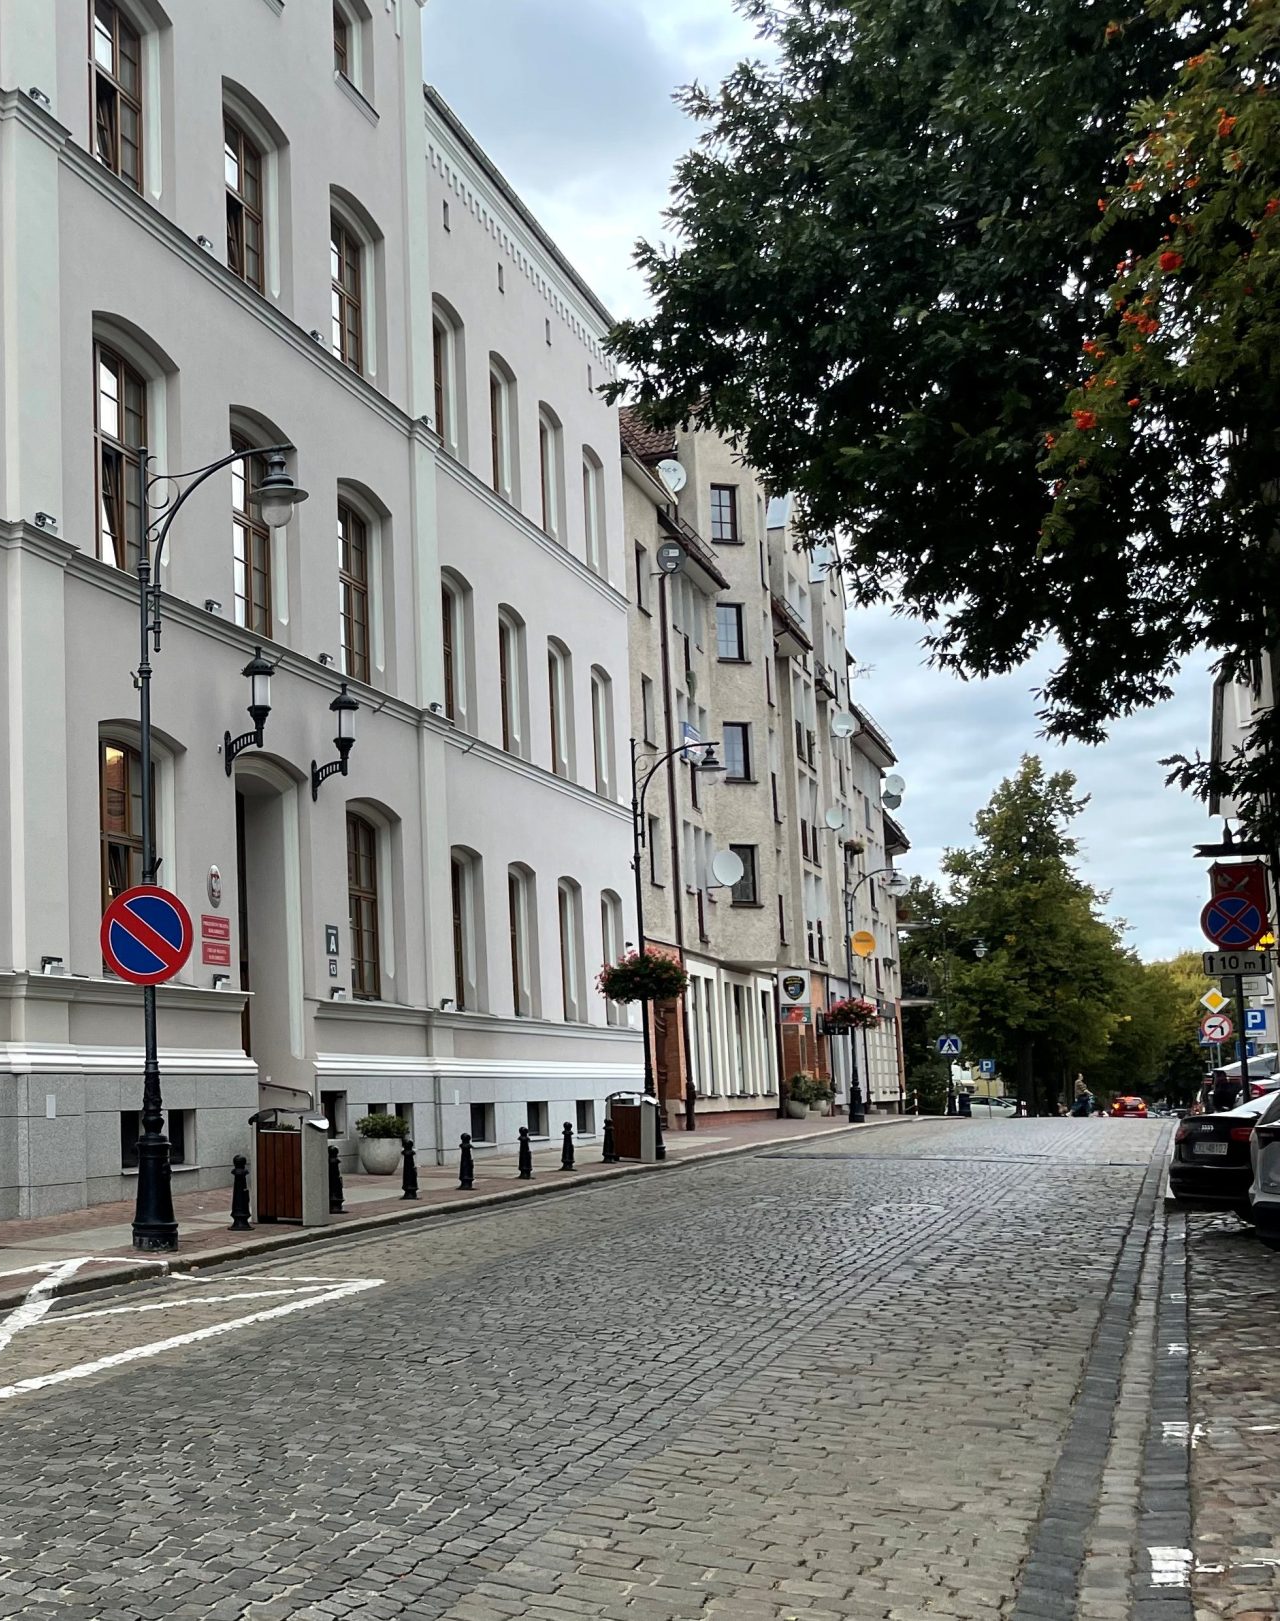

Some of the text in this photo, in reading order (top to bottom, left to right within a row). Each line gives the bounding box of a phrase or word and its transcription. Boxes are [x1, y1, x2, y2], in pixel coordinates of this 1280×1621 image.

[330, 936, 337, 952] A
[330, 964, 336, 975] 13
[1220, 955, 1256, 970] 10 m
[1247, 1011, 1262, 1028] P
[982, 1060, 992, 1071] P
